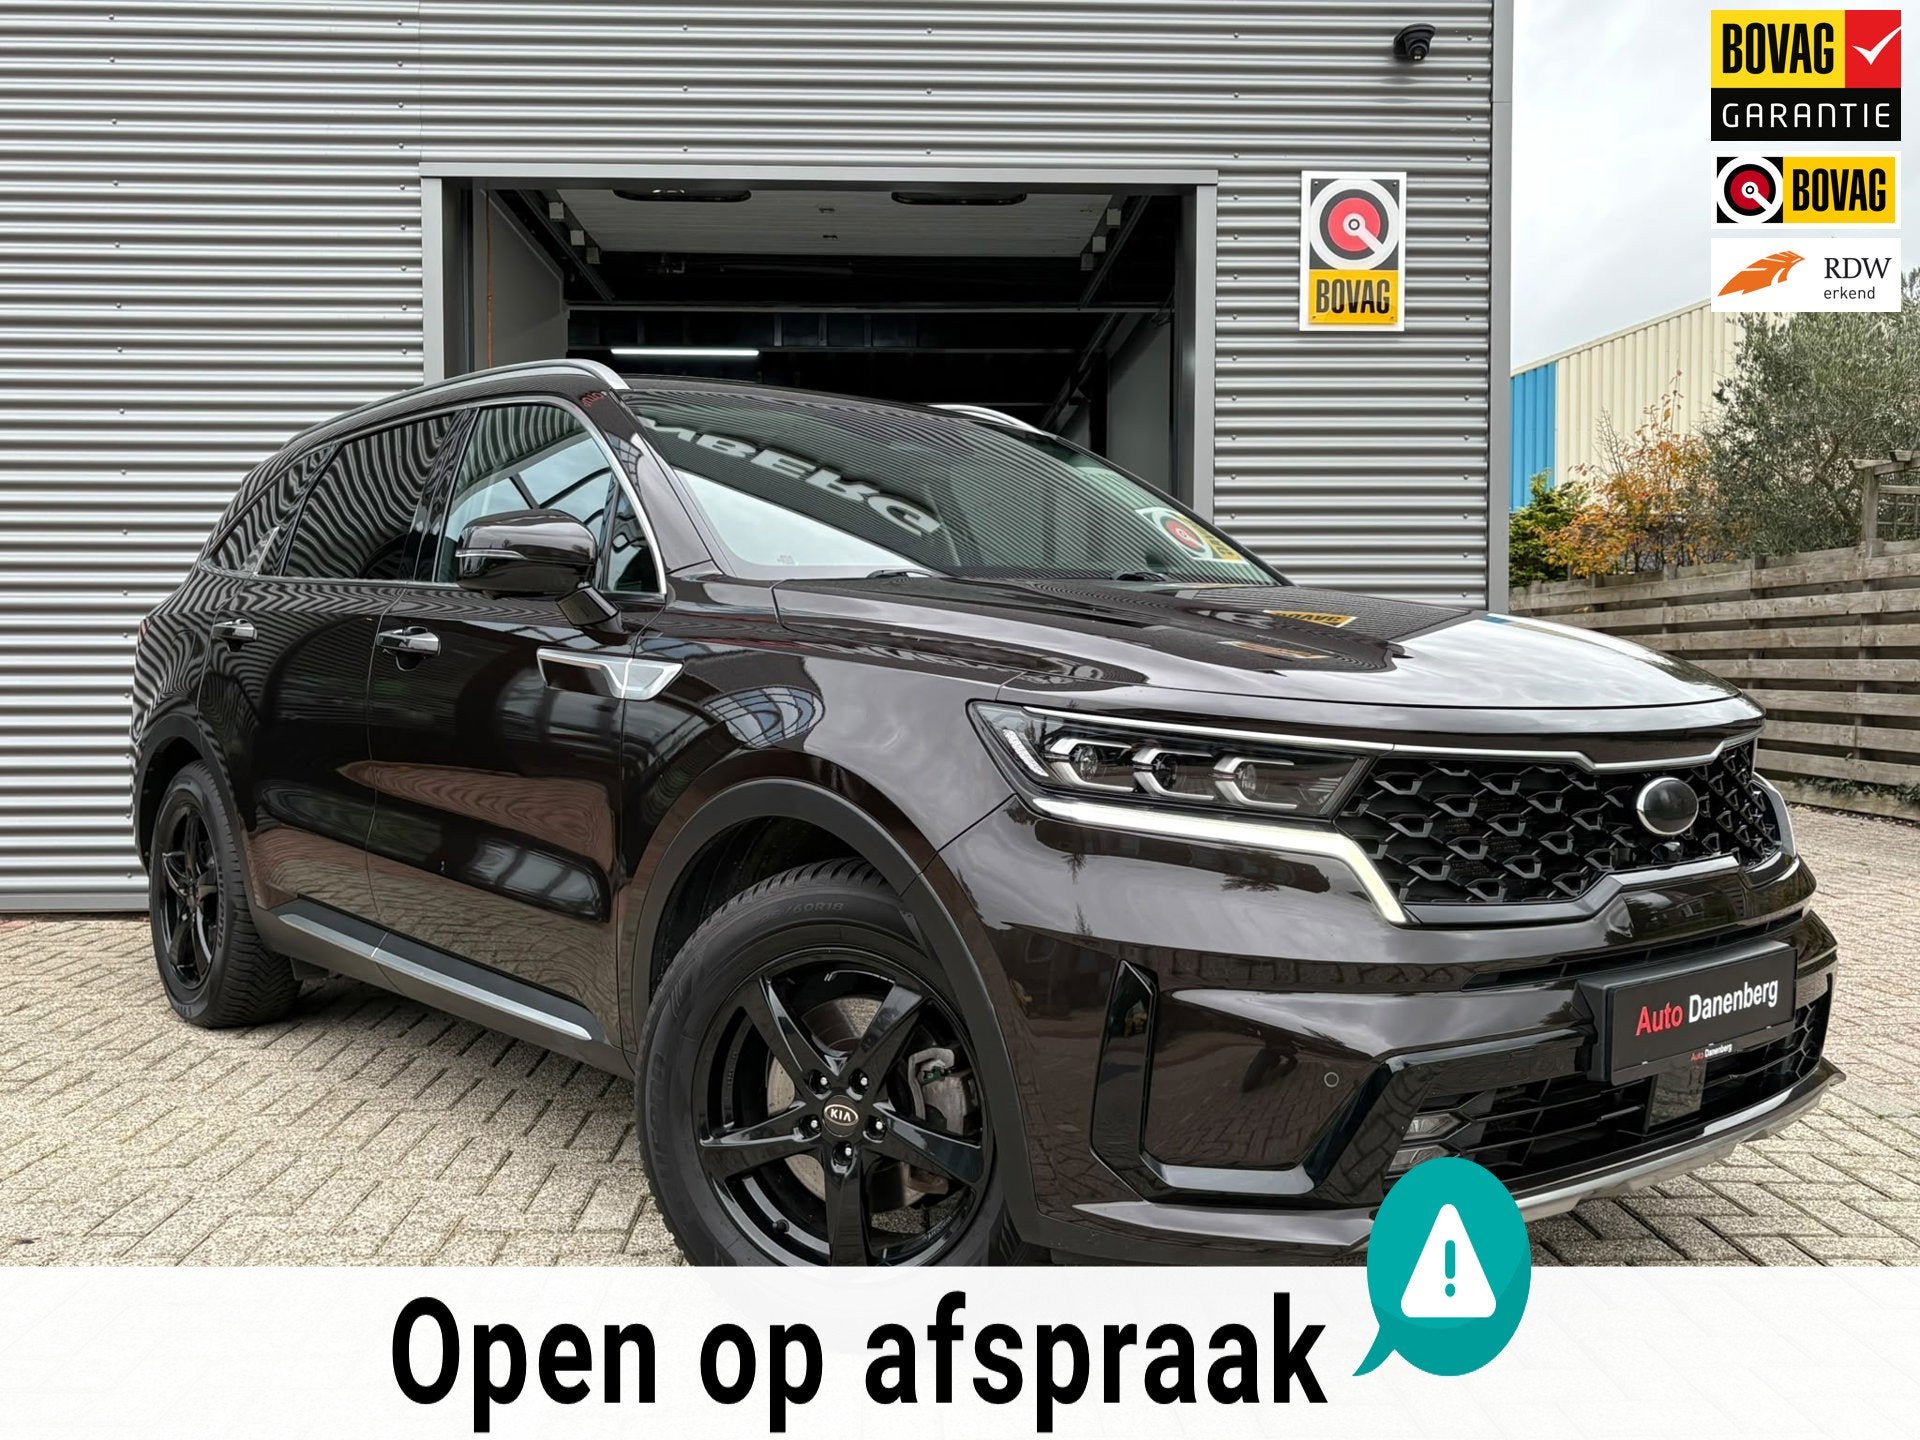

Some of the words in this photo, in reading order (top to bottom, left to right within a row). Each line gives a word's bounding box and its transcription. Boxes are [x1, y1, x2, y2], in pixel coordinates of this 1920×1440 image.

[1315, 278, 1390, 314] BOVAG
[1635, 1003, 1684, 1036] Auto
[1688, 979, 1779, 1023] Danenberg
[830, 1108, 851, 1122] KIA
